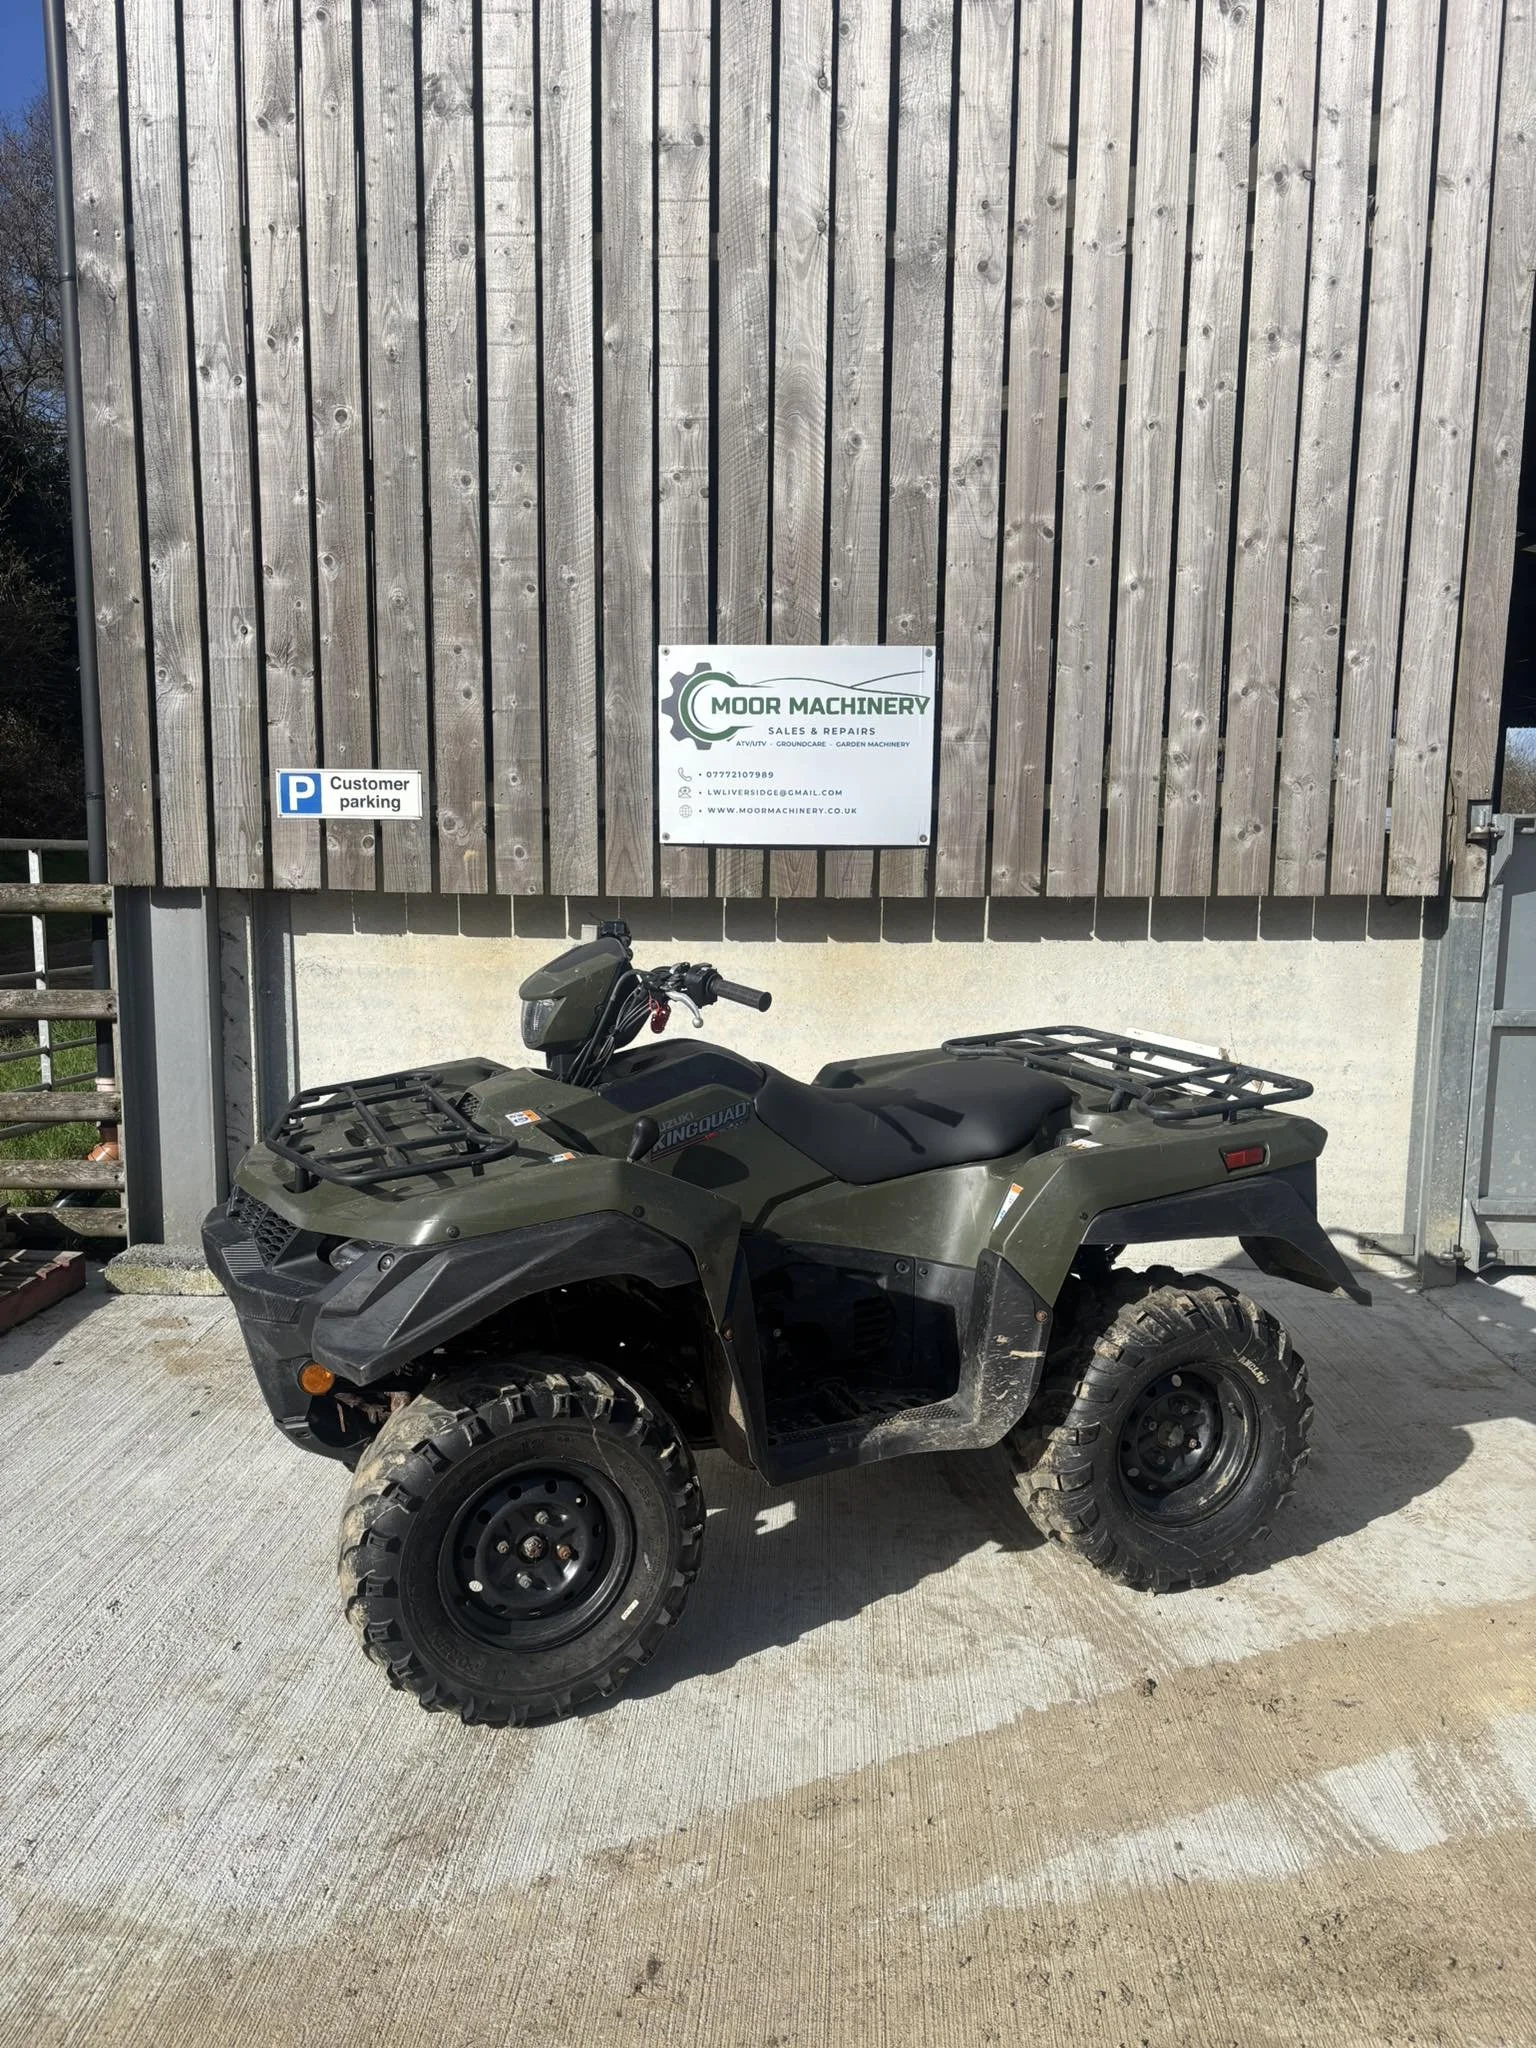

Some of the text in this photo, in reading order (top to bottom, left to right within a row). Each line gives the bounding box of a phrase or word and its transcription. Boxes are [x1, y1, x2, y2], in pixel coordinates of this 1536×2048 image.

[711, 696, 930, 715] MOOR MACHINERY
[768, 726, 876, 736] SALES & REPAIRS
[736, 740, 767, 748] ATV/UTV
[776, 740, 827, 748] GROUNDCARE
[836, 740, 866, 748] GARDEN
[706, 771, 774, 779] 07772107989
[330, 776, 410, 791] Customer
[288, 775, 315, 811] P
[707, 789, 843, 797] LWLIVERSIDGE@GMAIL.COM
[340, 795, 401, 811] parking
[707, 807, 857, 815] WWW.MOORMACHINERY.CO.UK
[652, 1102, 750, 1152] KINGQUAD
[658, 1111, 695, 1133] UZUKI
